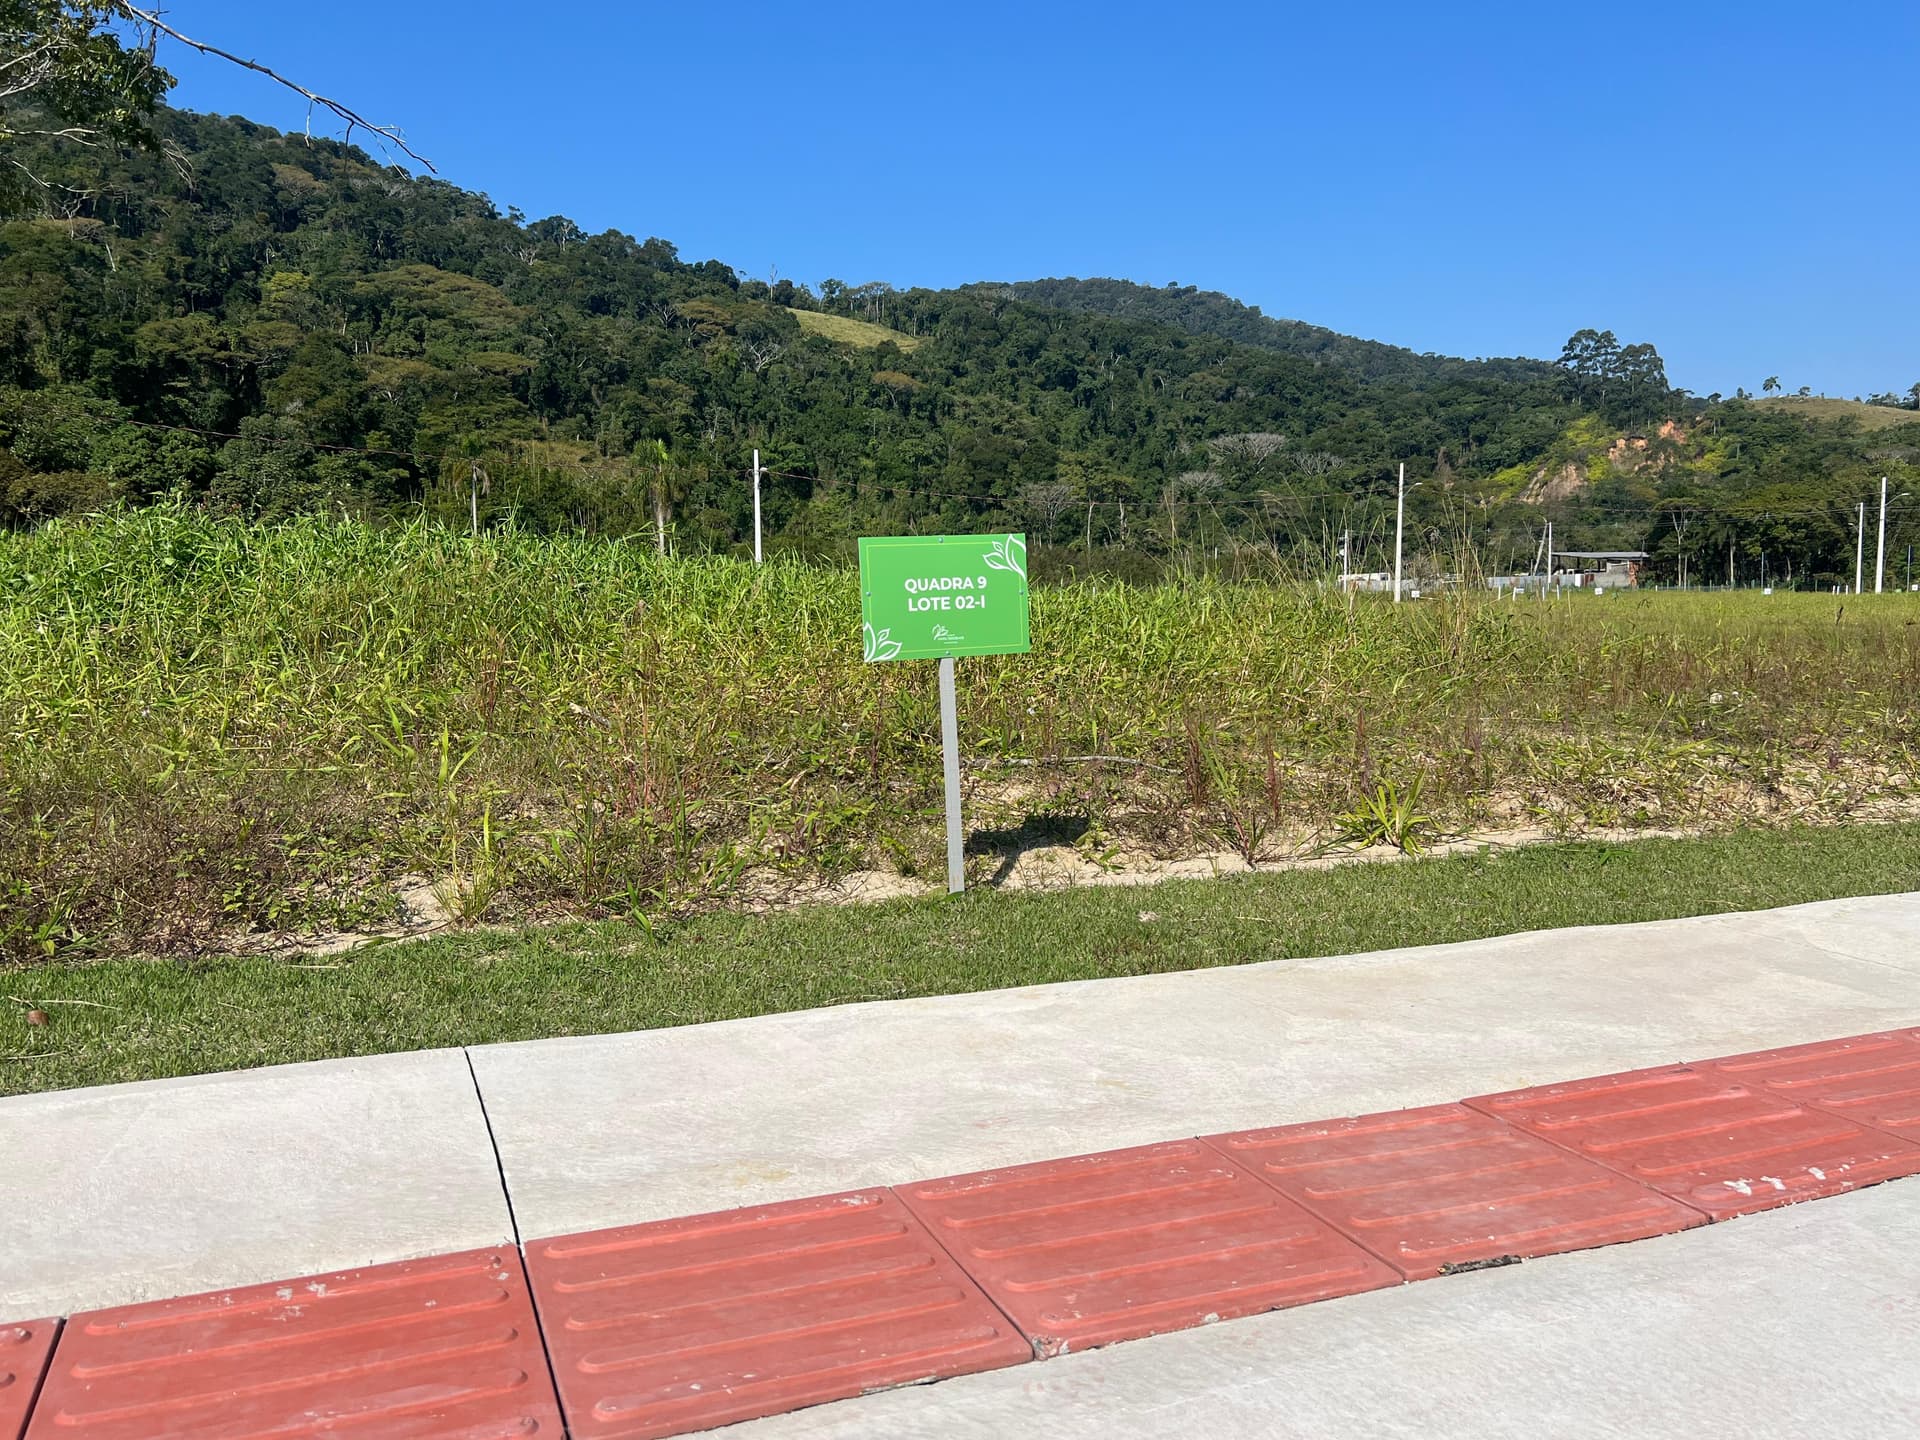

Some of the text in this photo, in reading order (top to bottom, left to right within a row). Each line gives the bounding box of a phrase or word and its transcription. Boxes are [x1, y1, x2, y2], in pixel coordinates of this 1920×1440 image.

[904, 576, 987, 594] QUADRA 9
[908, 597, 951, 612] LOTE
